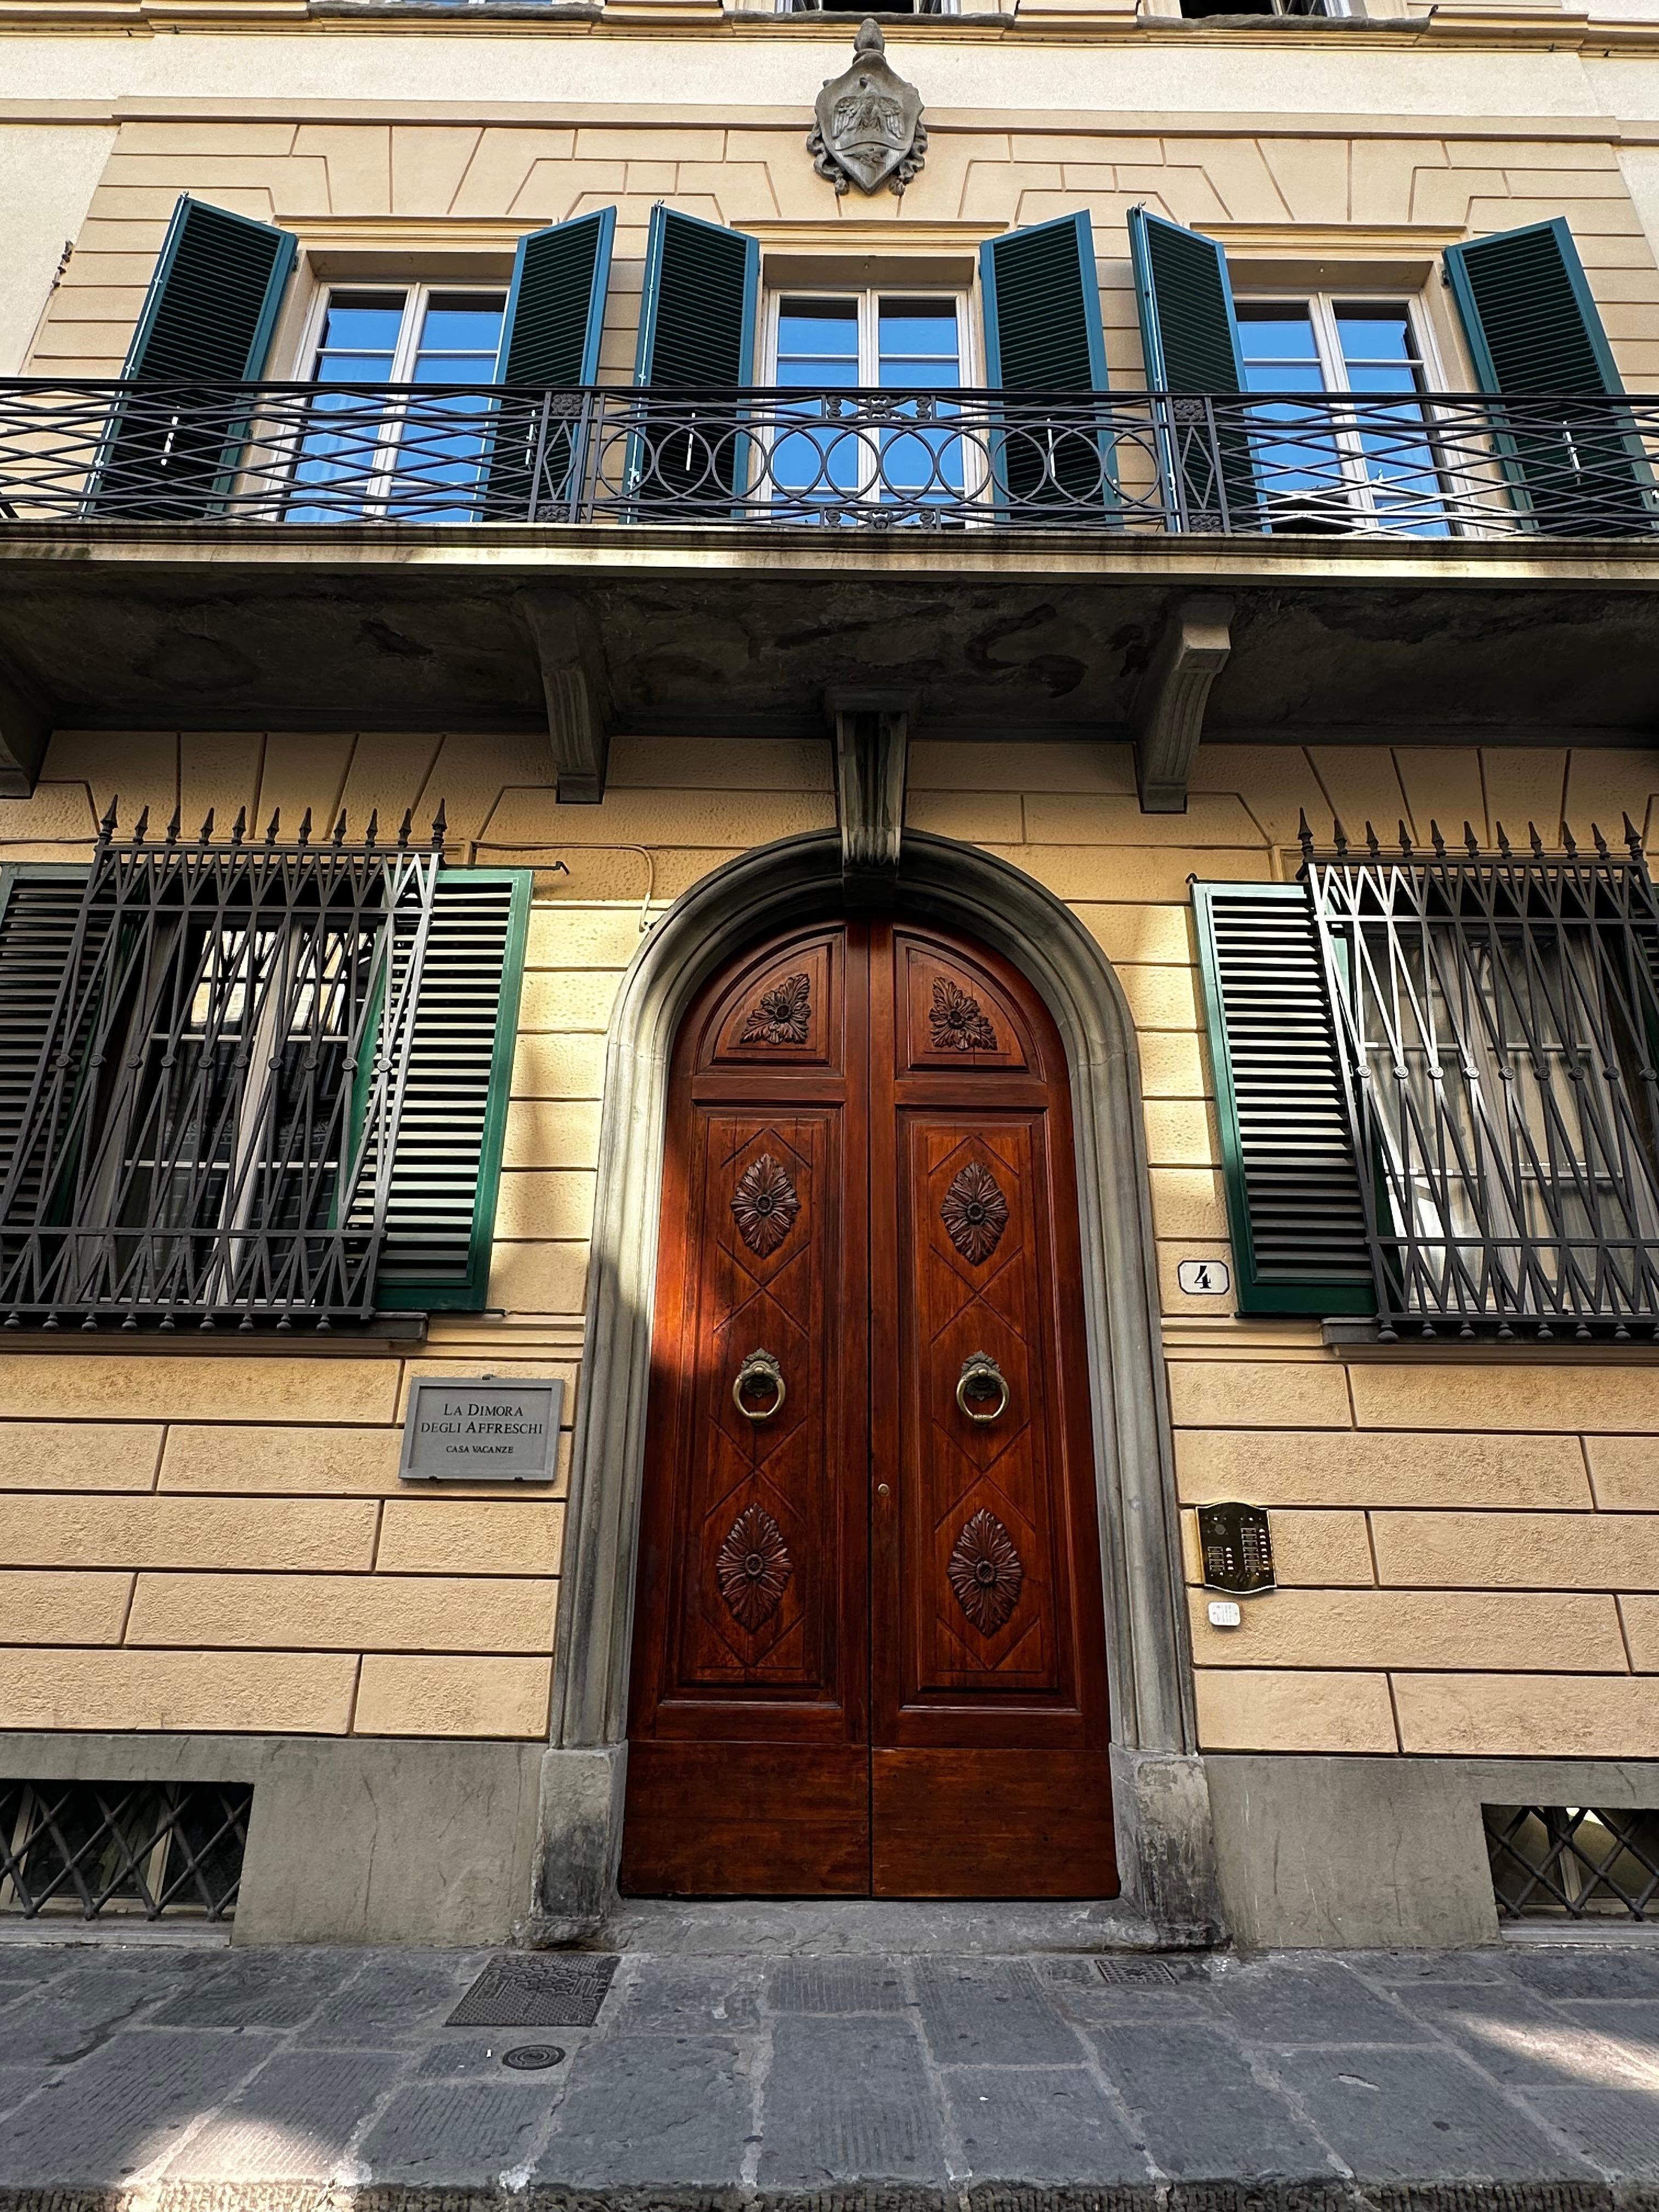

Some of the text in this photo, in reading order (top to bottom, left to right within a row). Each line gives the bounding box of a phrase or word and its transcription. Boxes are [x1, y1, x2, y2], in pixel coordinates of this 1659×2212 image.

[1194, 1265, 1211, 1289] 4
[443, 1403, 523, 1417] LA DIMORA
[421, 1421, 543, 1434] DEGLI AFFRESCHI
[446, 1445, 514, 1454] CASA VACANZE
